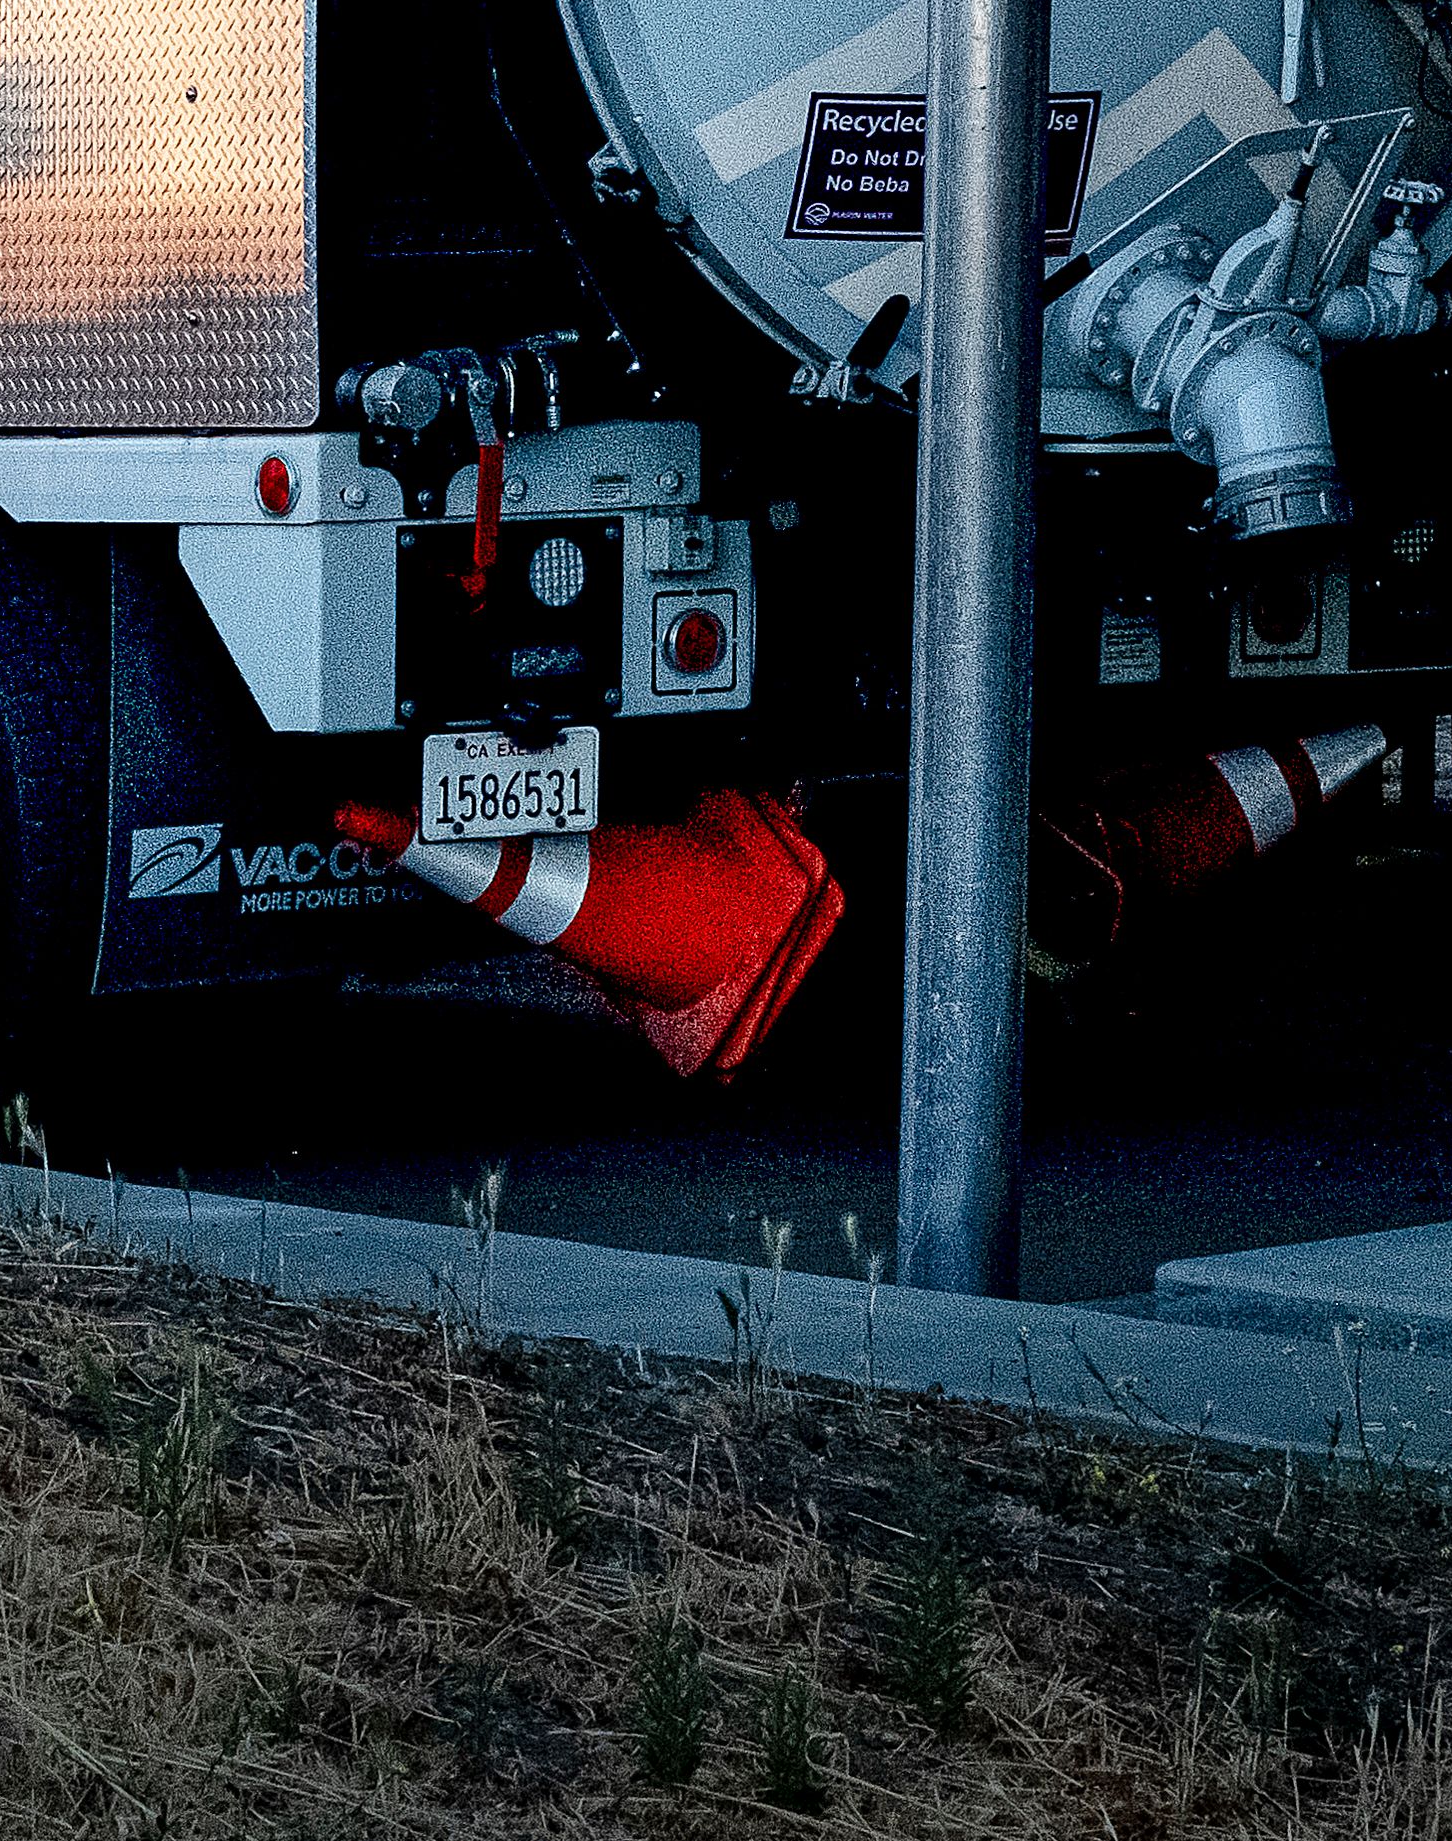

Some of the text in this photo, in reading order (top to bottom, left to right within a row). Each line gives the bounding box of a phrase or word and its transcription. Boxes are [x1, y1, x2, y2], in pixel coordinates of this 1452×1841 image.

[831, 148, 859, 166] Do
[865, 149, 899, 167] Not
[826, 174, 910, 193] No Beba
[467, 744, 489, 759] CA
[436, 768, 586, 824] 1586531
[240, 890, 291, 914] MORE
[295, 887, 359, 909] POWER
[364, 885, 386, 905] TO
